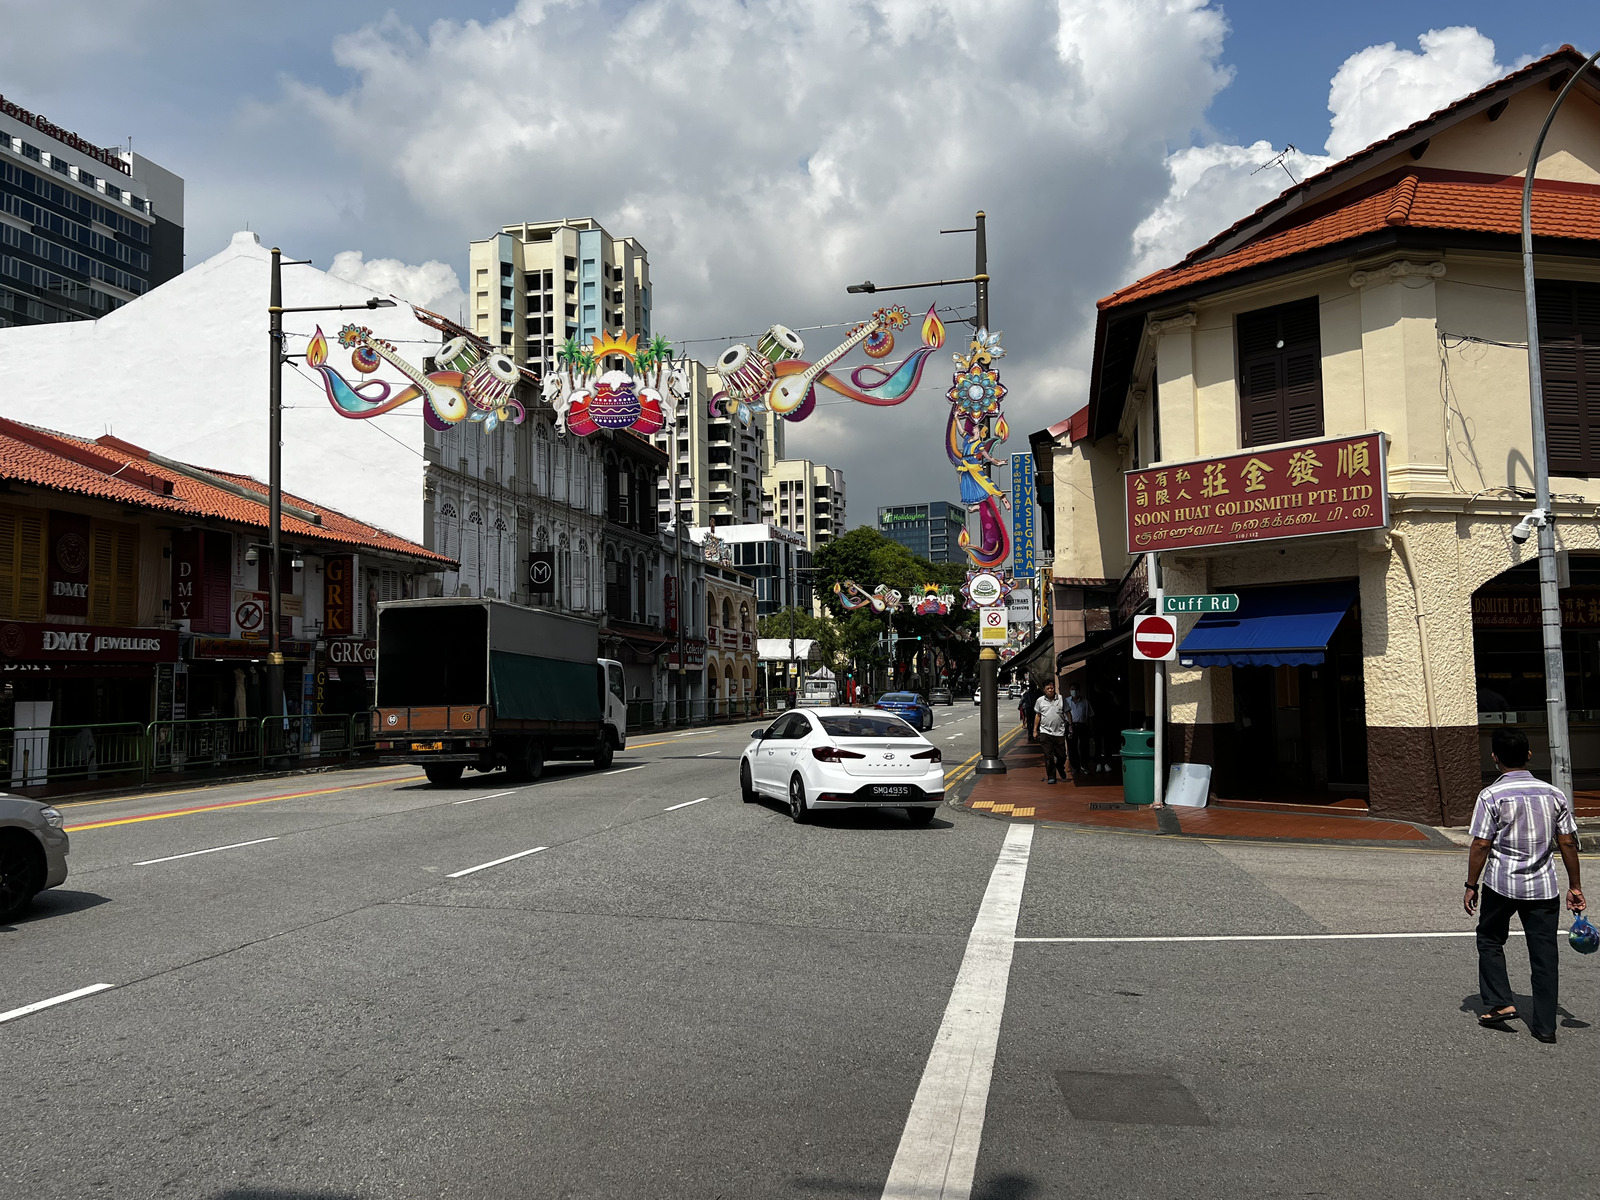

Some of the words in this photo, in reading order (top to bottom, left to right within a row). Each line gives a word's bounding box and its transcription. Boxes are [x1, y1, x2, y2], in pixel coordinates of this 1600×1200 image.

[1024, 454, 1034, 570] SELVASEGARA
[1134, 510, 1170, 527] SOON
[1174, 504, 1212, 522] HUAT
[1215, 493, 1303, 517] GOLDSMITH
[1308, 488, 1338, 506] PTE
[1342, 485, 1373, 502] LTD
[52, 580, 89, 598] DMY
[178, 561, 193, 617] DMY
[326, 559, 343, 630] GRK
[1167, 597, 1204, 611] Cuff
[1211, 596, 1230, 610] Rd
[41, 630, 92, 652] DMY
[93, 636, 161, 653] JEWELLERS
[330, 642, 364, 663] GRK
[316, 671, 326, 715] GRK
[873, 786, 909, 795] SMQ493S
